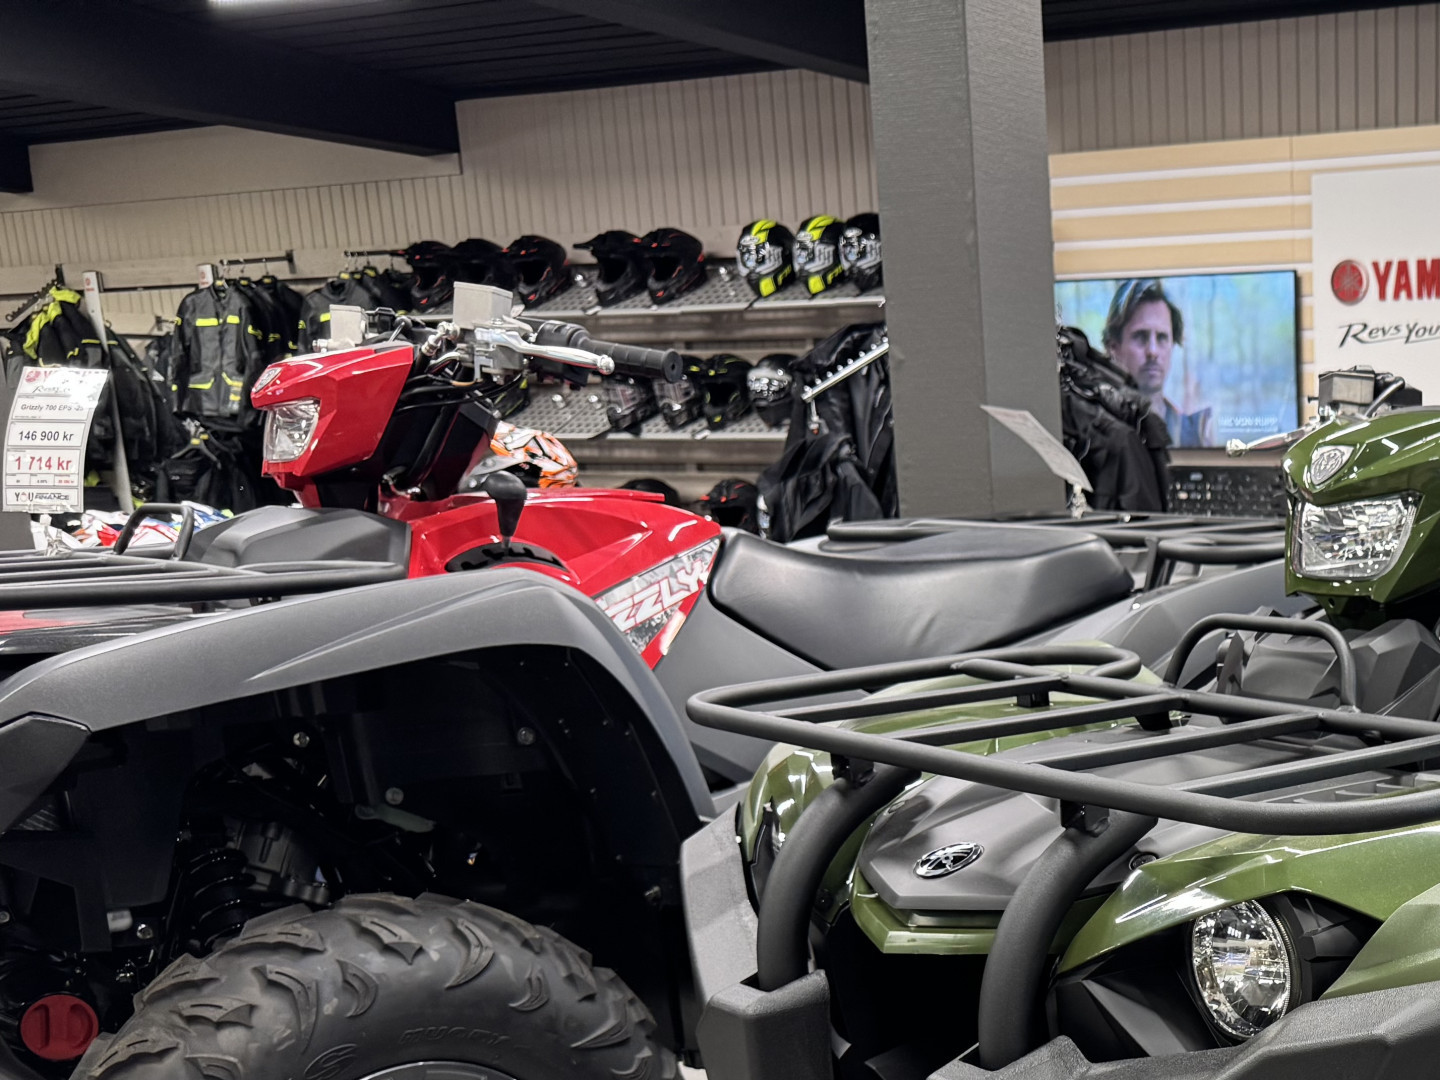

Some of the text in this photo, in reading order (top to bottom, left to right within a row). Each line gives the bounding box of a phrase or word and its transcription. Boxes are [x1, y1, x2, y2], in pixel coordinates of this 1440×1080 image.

[1338, 322, 1402, 348] Revs
[20, 403, 44, 411] Grizzly
[19, 430, 74, 442] 146 900 kr
[15, 456, 72, 471] 1 714 kr
